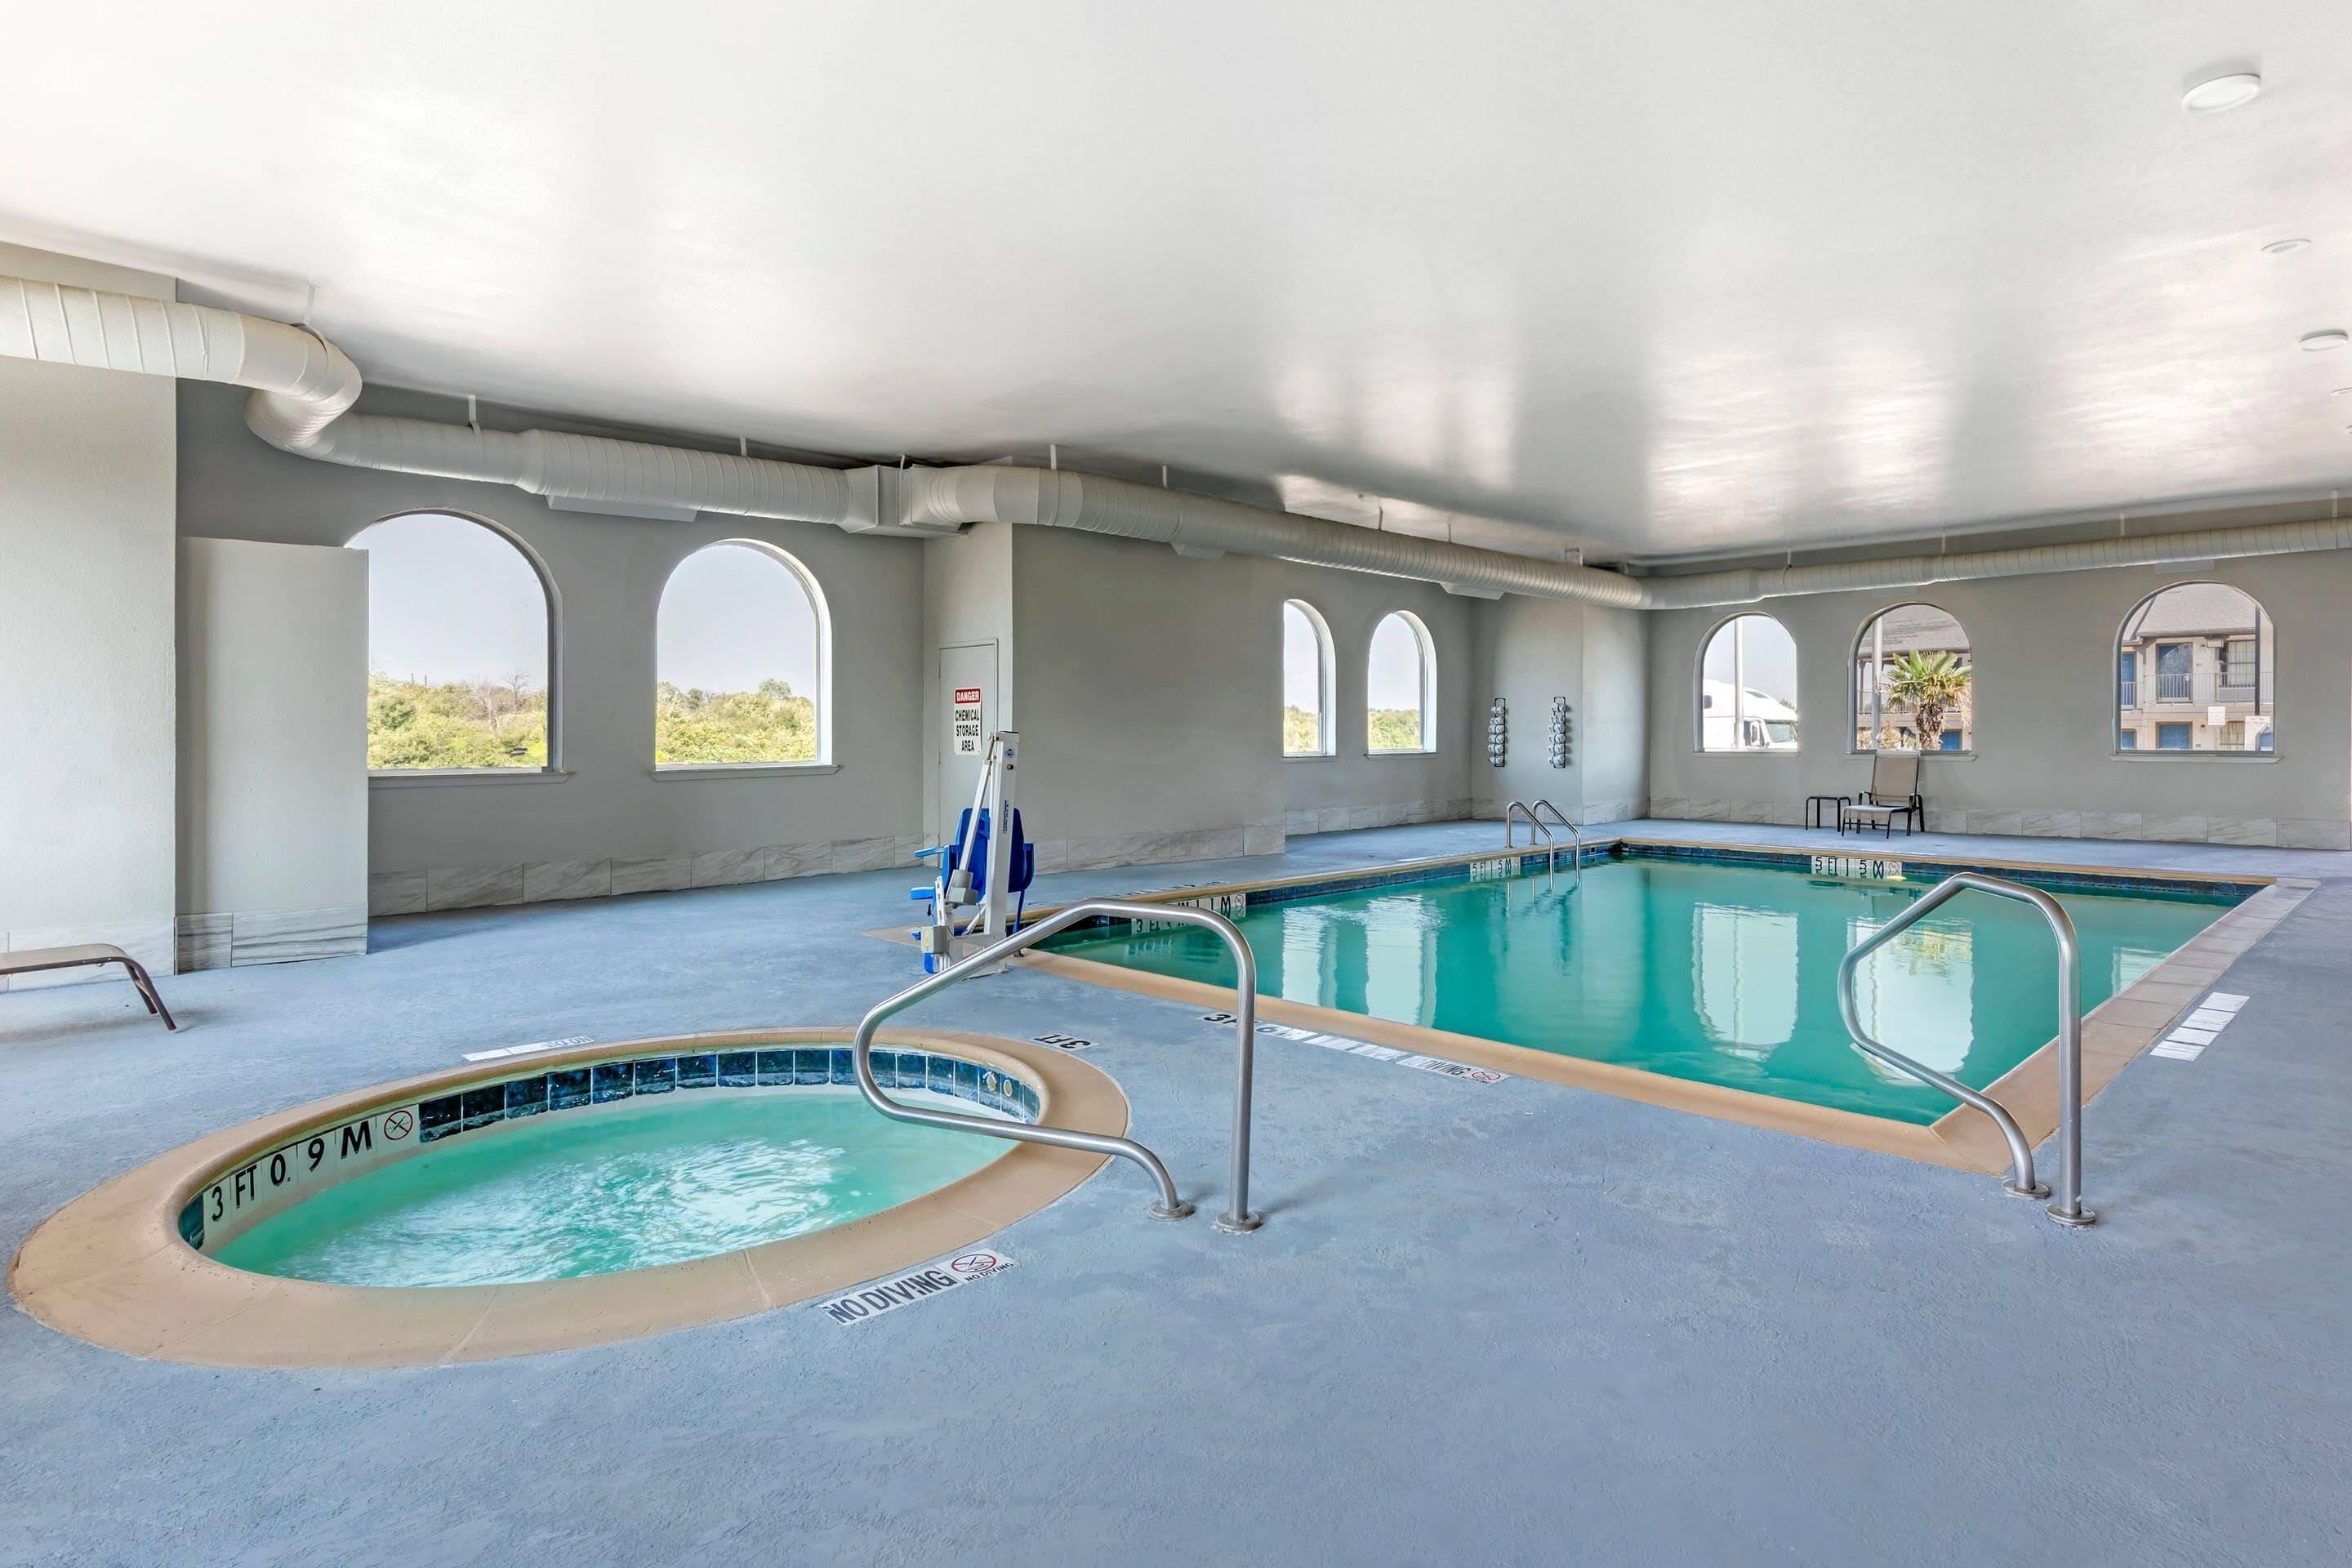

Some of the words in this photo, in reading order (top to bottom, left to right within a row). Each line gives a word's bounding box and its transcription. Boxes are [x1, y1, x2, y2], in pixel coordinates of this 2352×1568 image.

[956, 691, 980, 702] DANGER
[956, 709, 980, 721] CHEMICAL
[956, 725, 979, 737] STORAGE
[961, 740, 975, 751] AREA
[211, 1185, 224, 1222] 3
[234, 1164, 257, 1209] FT
[341, 1120, 372, 1160] M
[825, 1298, 870, 1324] NO
[858, 1270, 958, 1311] DIVING
